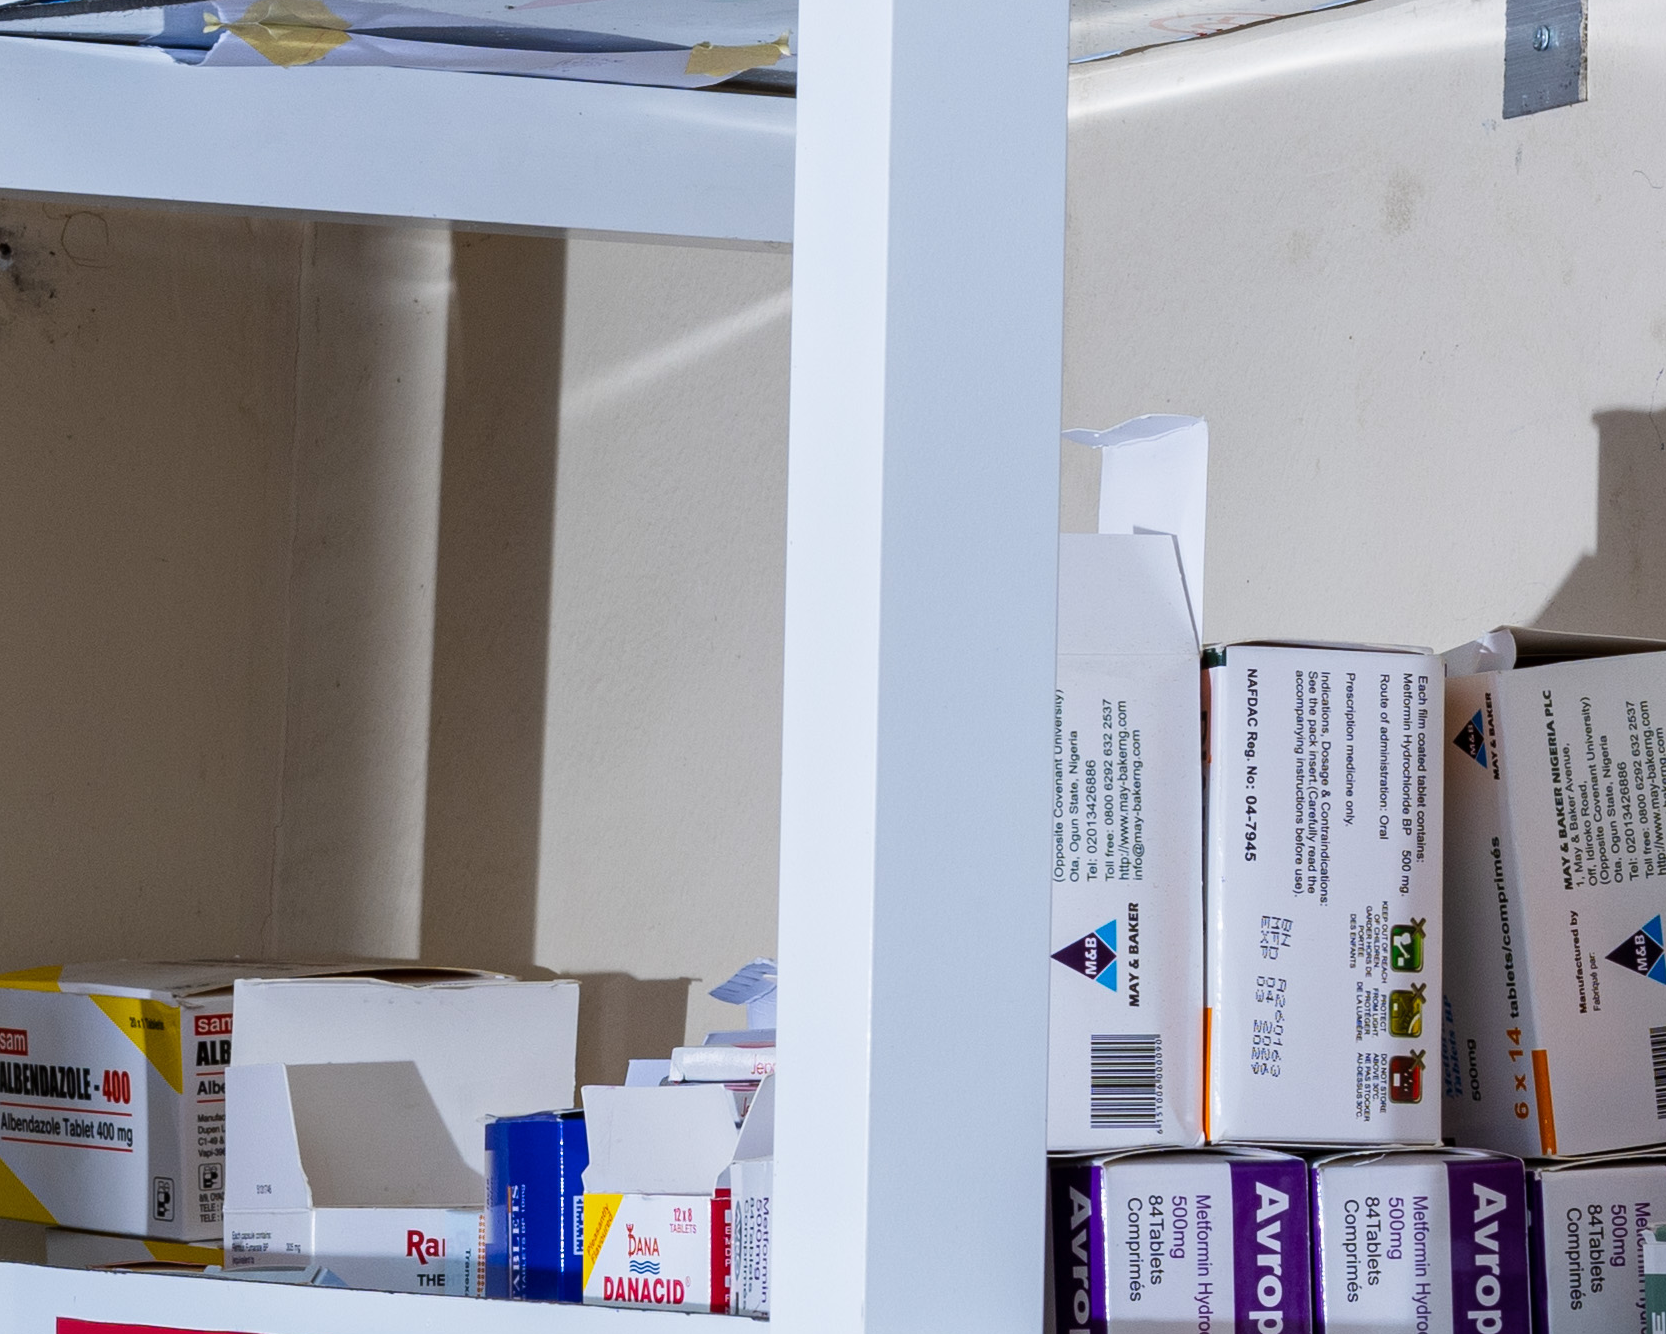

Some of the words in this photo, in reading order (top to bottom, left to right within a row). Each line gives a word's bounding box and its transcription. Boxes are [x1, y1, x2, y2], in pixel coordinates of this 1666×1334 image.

[1244, 667, 1259, 726] NAFDAC
[1244, 730, 1259, 761] Reg.
[1243, 765, 1258, 790] No:
[1243, 794, 1257, 863] 04-7945
[1128, 902, 1140, 955] BAKER
[1129, 957, 1139, 969] &
[1129, 971, 1140, 1007] MAY
[0, 1060, 92, 1101] ALBENDAZOLE
[102, 1069, 131, 1105] 400
[0, 1112, 61, 1137] Albendazole
[63, 1118, 95, 1140] Tablet
[96, 1121, 115, 1140] 400
[117, 1128, 133, 1147] mg
[626, 1231, 660, 1257] DANA
[1388, 1196, 1402, 1261] 500mg
[1343, 1198, 1359, 1304] Comprimés
[603, 1276, 686, 1305] DANACID
